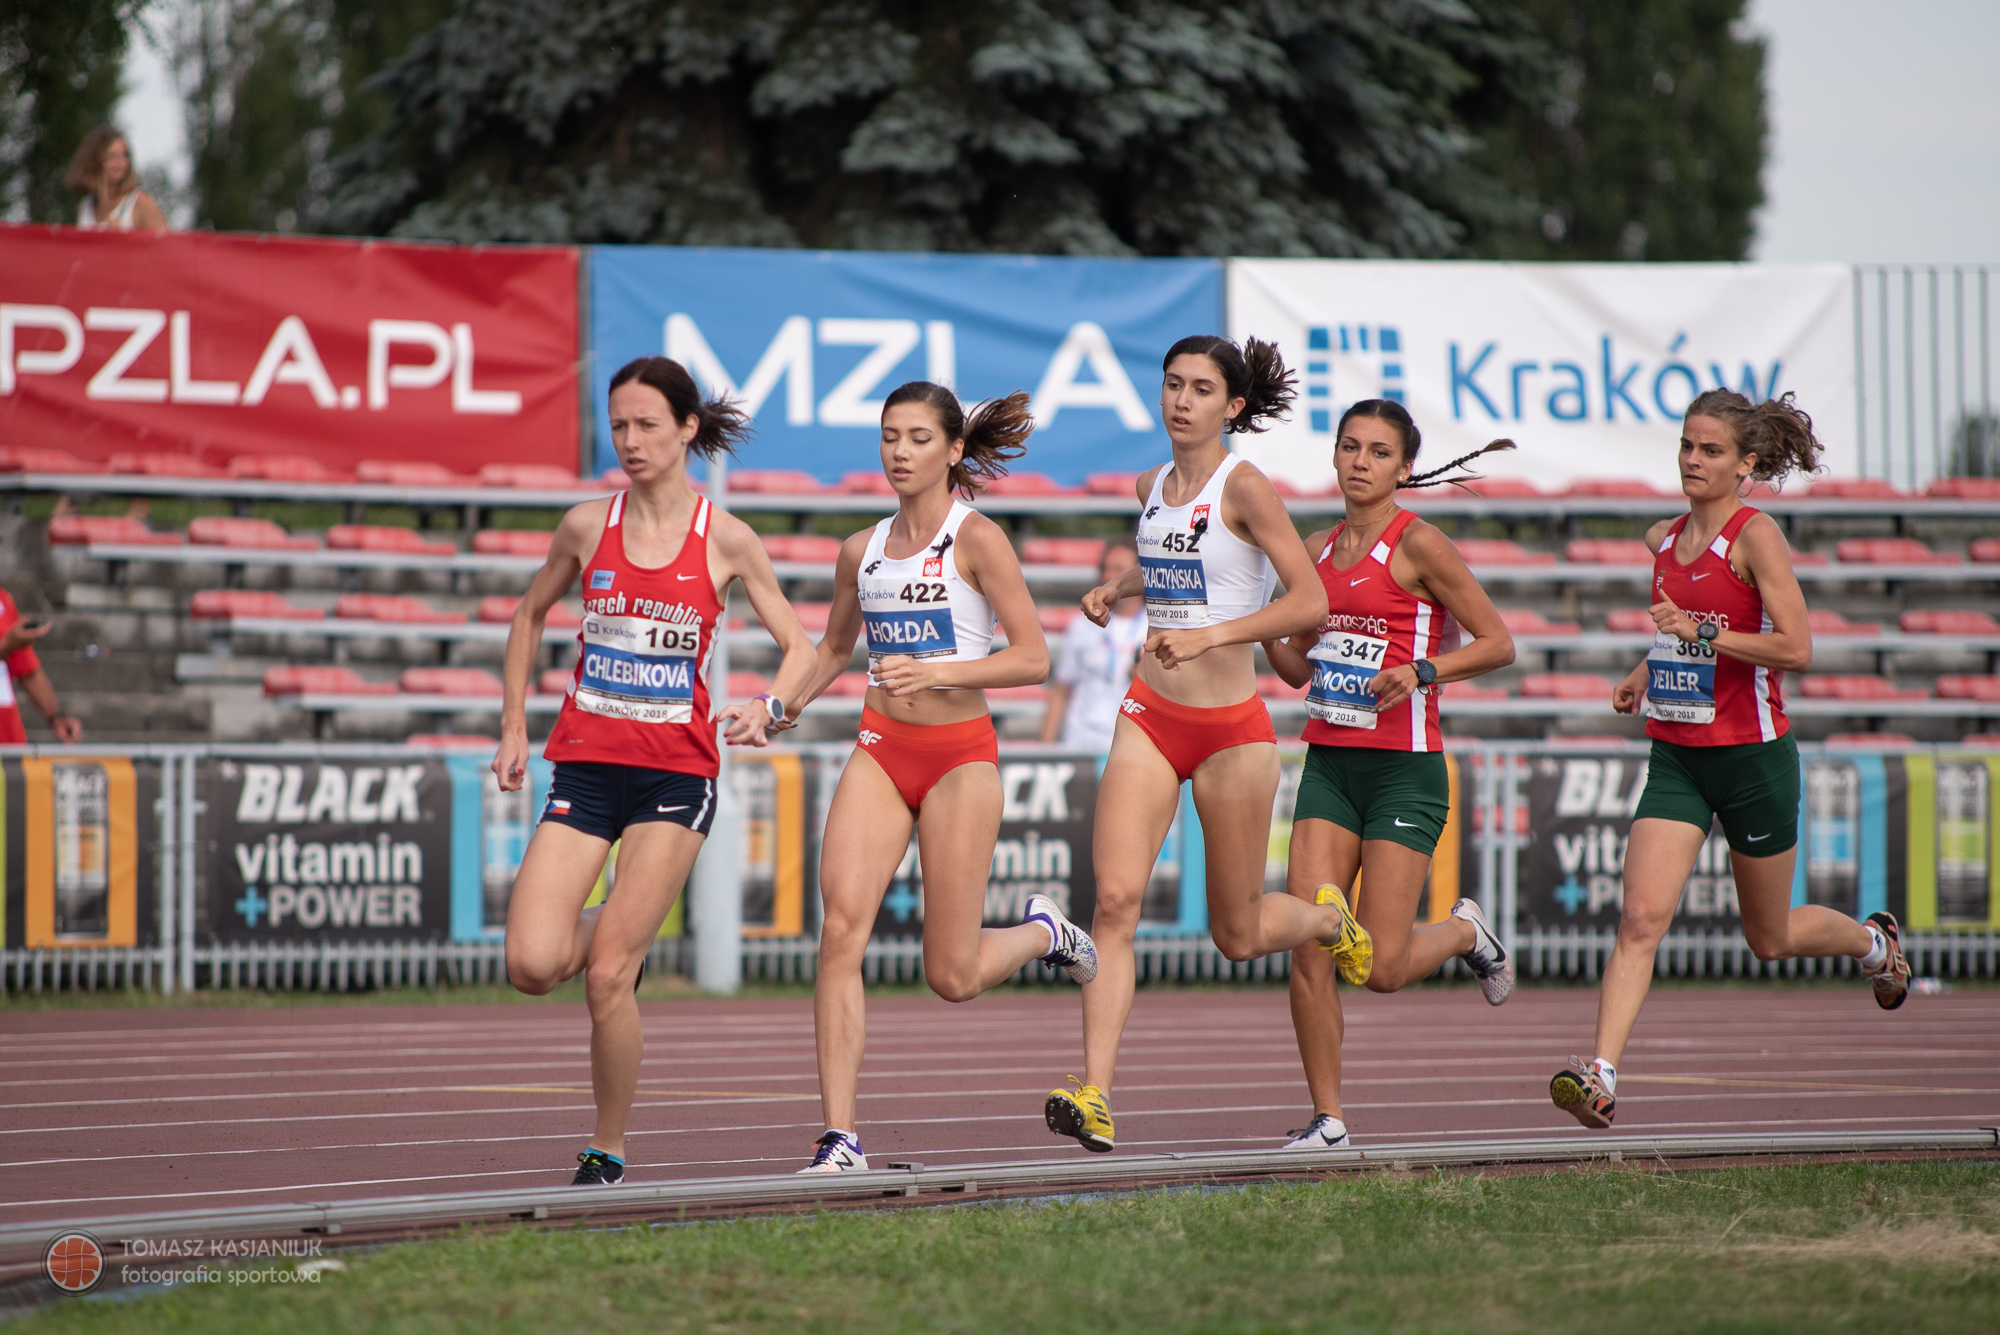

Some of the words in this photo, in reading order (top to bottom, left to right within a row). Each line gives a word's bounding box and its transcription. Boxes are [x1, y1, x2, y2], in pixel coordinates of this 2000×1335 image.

[866, 588, 896, 600] Kraków
[900, 582, 949, 604] 422
[586, 590, 627, 615] czech
[632, 597, 703, 626] republic
[1169, 610, 1189, 618] 2018
[602, 626, 638, 640] Kraków
[645, 627, 698, 651] 105
[869, 619, 941, 644] HOŁDA
[1340, 638, 1385, 663] 347
[586, 653, 690, 689] CHLEBIKOVÁ
[594, 702, 641, 717] KRAKÓW
[643, 708, 669, 719] 2018
[1334, 712, 1357, 723] 2018
[1677, 710, 1696, 719] 2018
[236, 764, 426, 823] BLACK
[235, 833, 423, 884] vitamin
